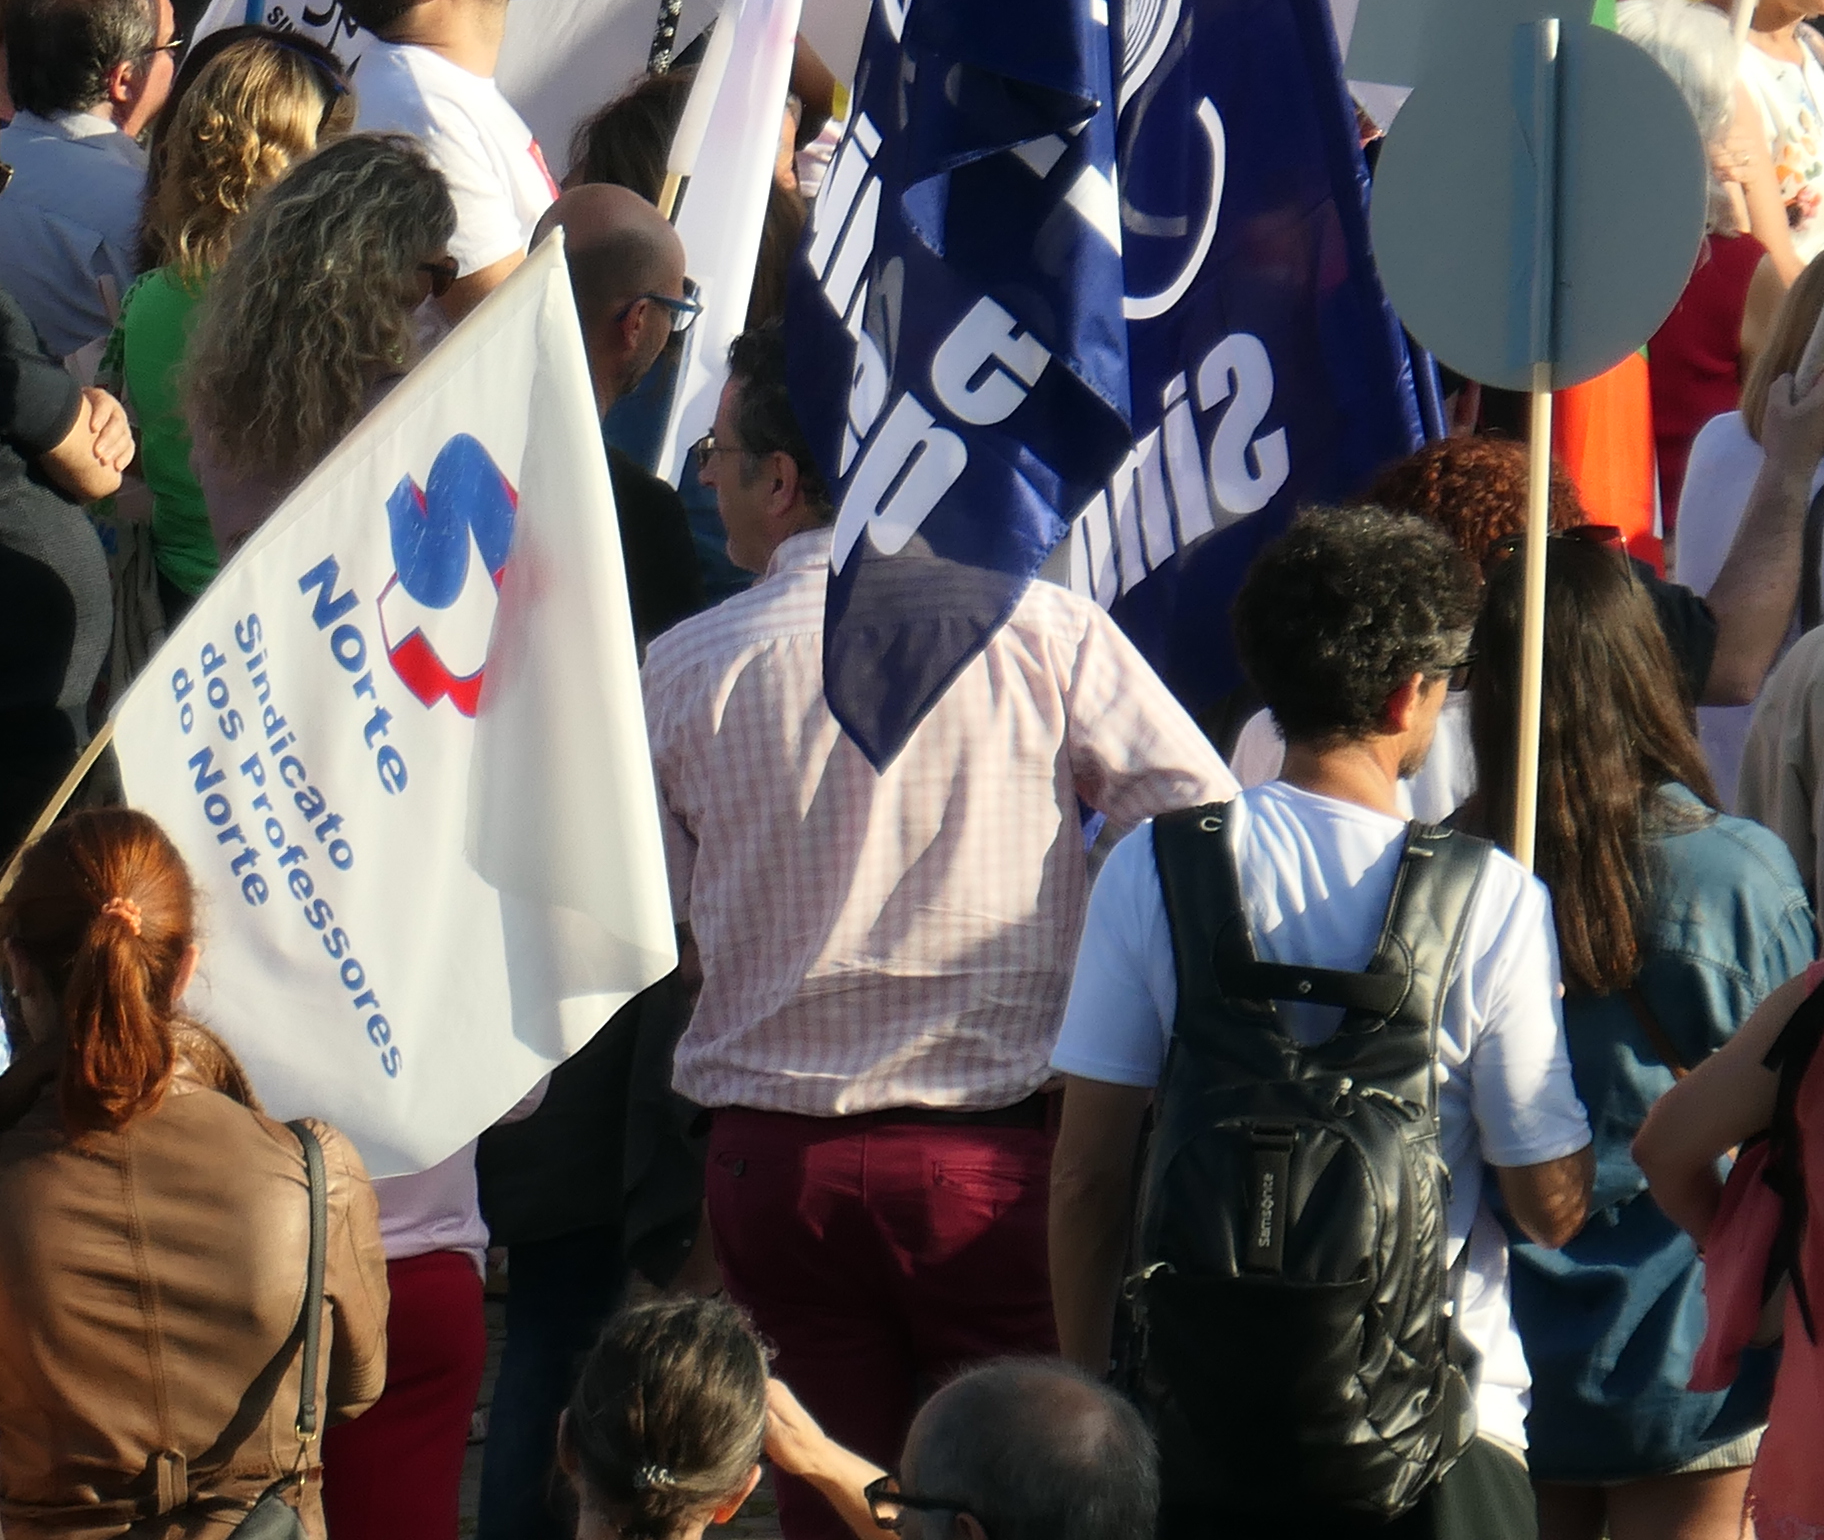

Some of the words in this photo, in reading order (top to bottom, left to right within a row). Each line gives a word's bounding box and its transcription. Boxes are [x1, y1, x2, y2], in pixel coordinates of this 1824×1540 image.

[171, 667, 195, 735] do
[187, 746, 271, 909] Norte
[234, 612, 355, 872] Sindicato
[298, 553, 409, 796] Norte
[201, 641, 244, 743] dos
[239, 752, 404, 1080] Professores
